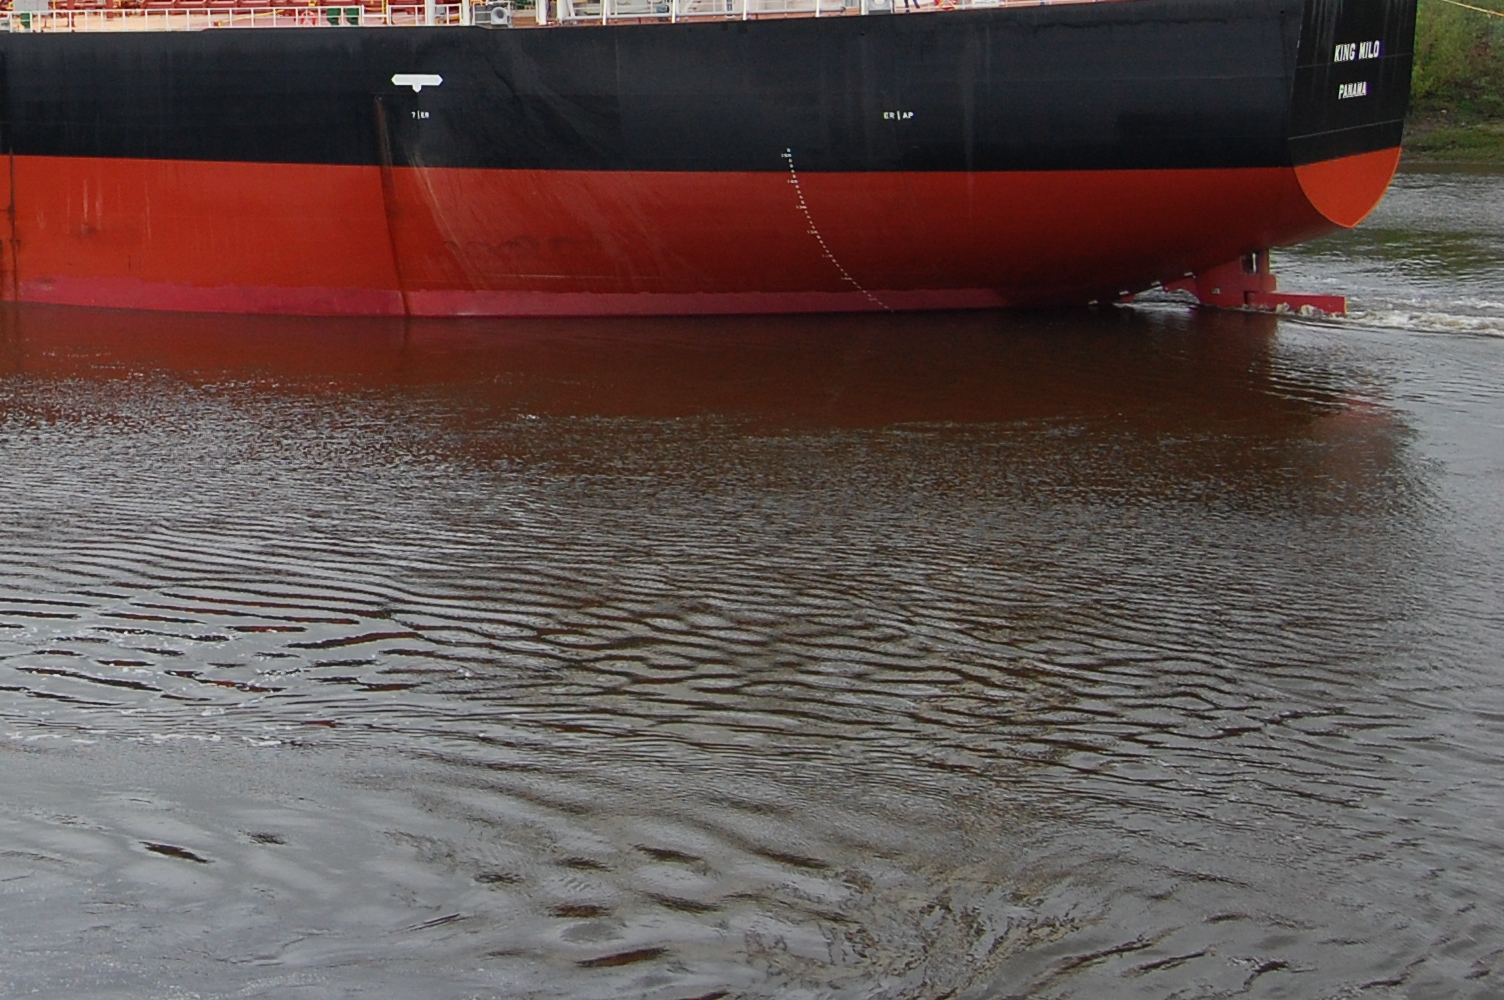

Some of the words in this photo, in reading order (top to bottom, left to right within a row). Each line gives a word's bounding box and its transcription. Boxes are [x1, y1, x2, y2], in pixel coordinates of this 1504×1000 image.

[1334, 43, 1356, 62] KING
[1359, 40, 1380, 60] MILO
[1338, 81, 1367, 99] PANAMA
